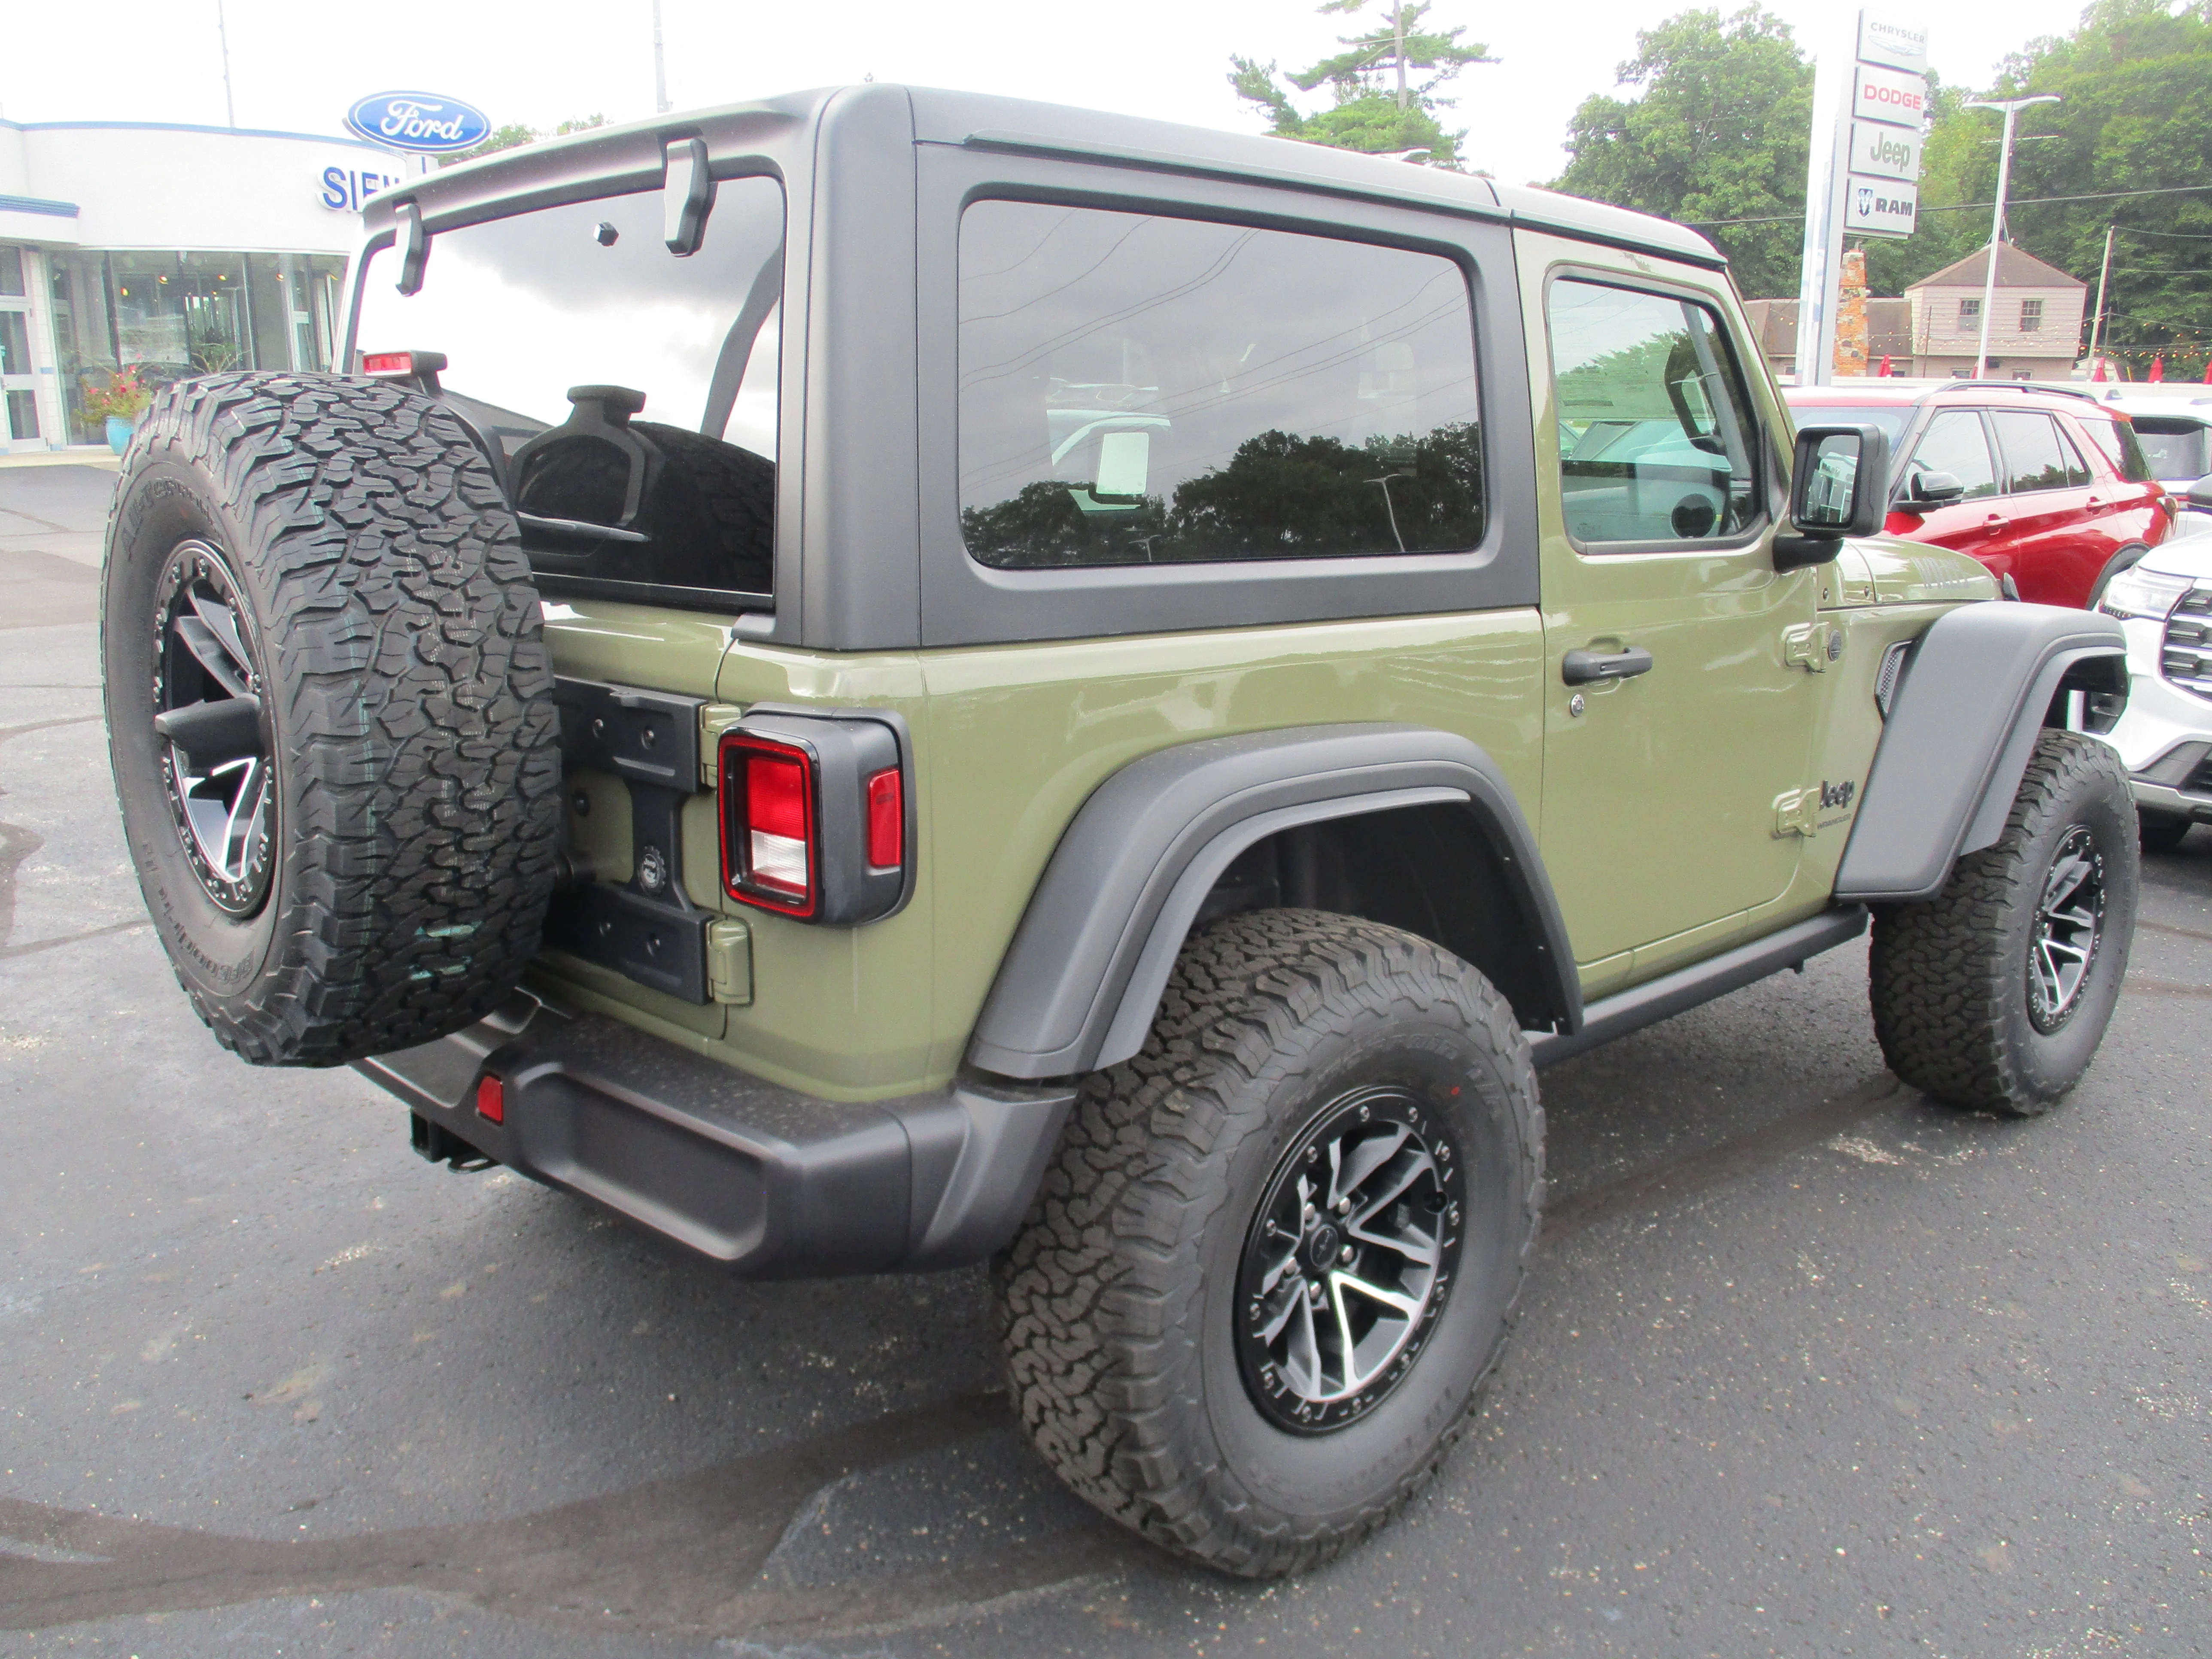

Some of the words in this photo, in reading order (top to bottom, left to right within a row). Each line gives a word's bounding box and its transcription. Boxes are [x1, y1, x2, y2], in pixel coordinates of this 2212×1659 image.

[1871, 22, 1925, 44] CHRYSLER
[1864, 84, 1921, 110] DODGE
[380, 100, 464, 140] Ford
[1870, 131, 1910, 172] Jeep
[1875, 197, 1913, 216] RAM
[1819, 779, 1855, 811] Jeep
